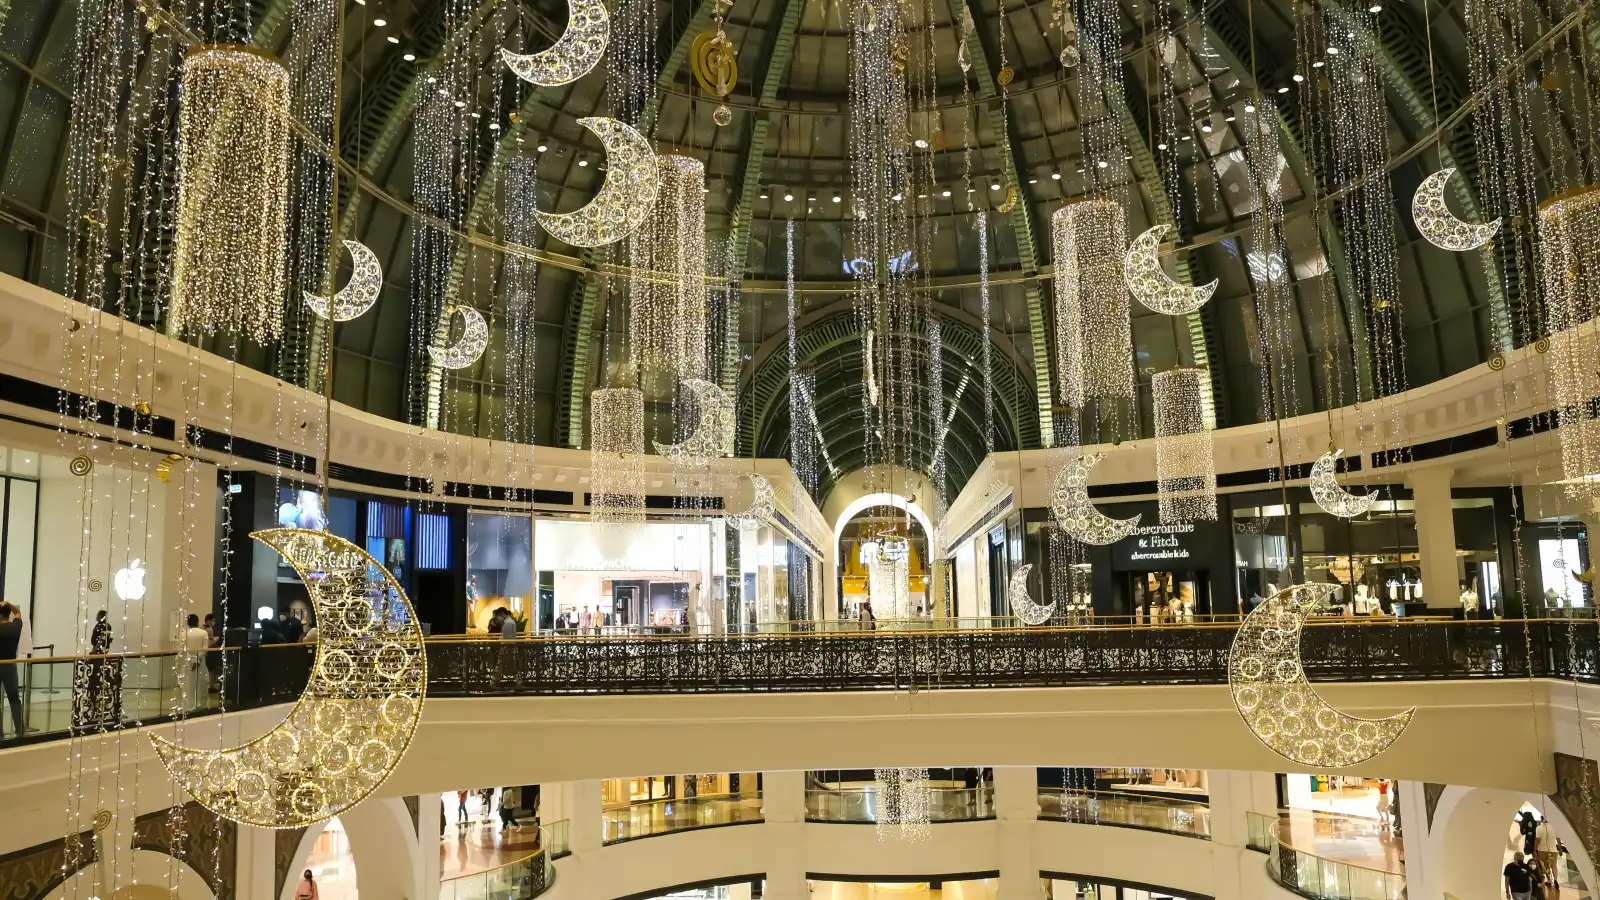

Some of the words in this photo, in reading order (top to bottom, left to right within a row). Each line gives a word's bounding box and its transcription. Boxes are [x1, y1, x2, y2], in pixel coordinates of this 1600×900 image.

[1128, 521, 1194, 536] Abercrombie
[1138, 538, 1148, 548] &
[1150, 534, 1179, 548] Fitch
[1174, 549, 1189, 558] kids
